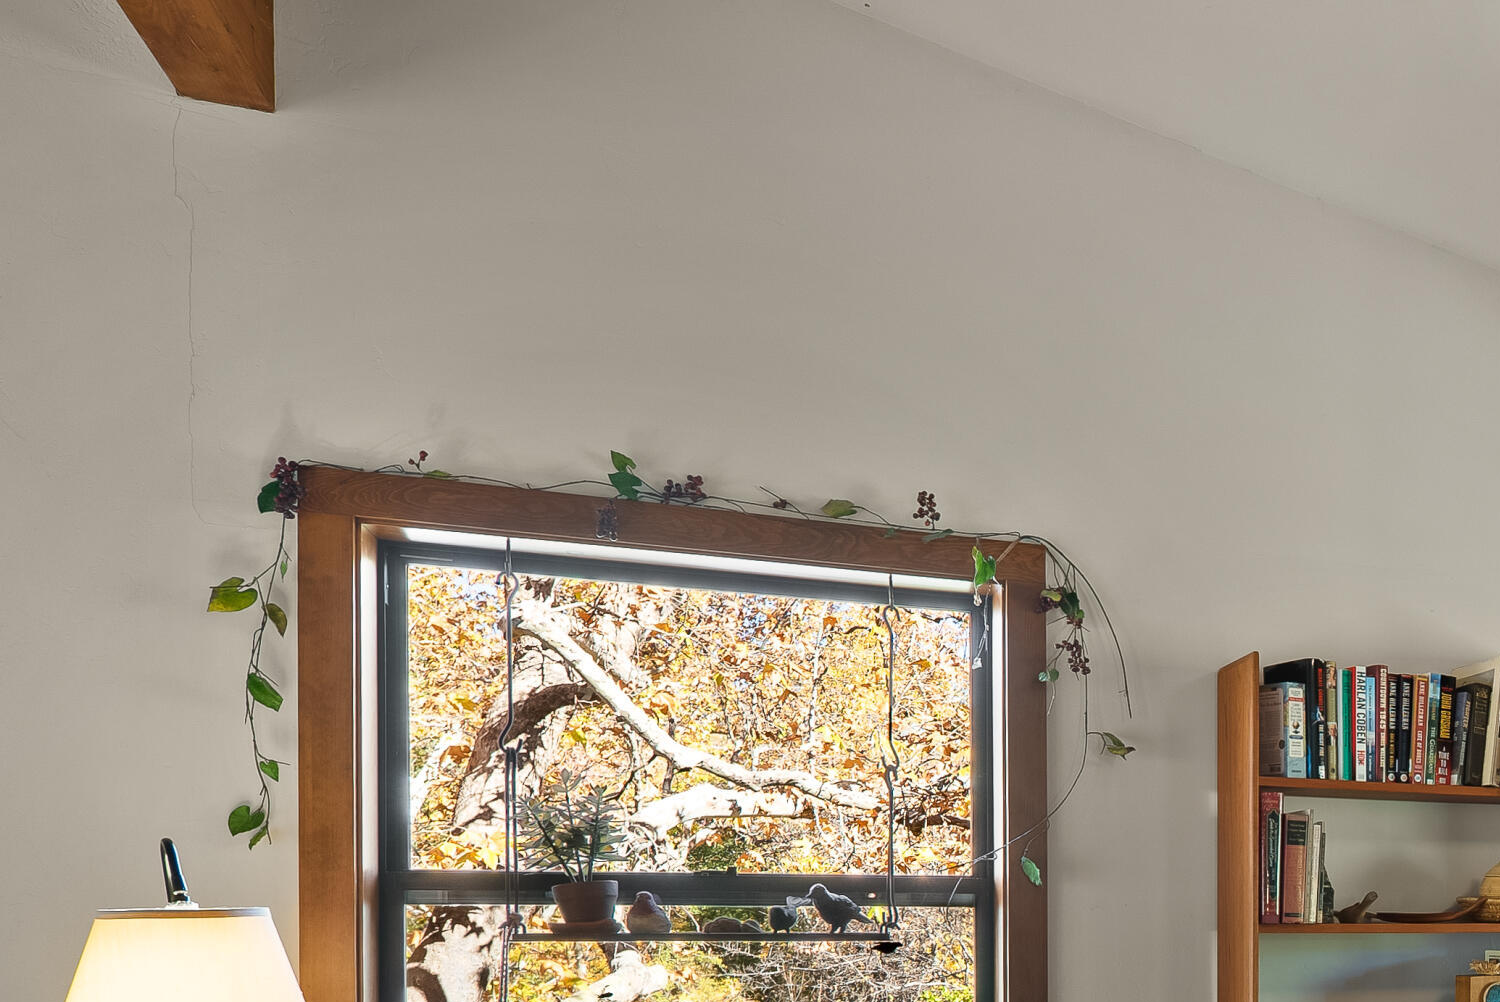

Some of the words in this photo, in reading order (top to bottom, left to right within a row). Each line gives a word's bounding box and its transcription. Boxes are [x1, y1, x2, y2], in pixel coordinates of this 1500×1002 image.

[1357, 672, 1367, 710] HARLAN
[1441, 692, 1452, 709] JOHN
[1357, 712, 1367, 745] COBEN
[1440, 710, 1452, 739] GRISHAM
